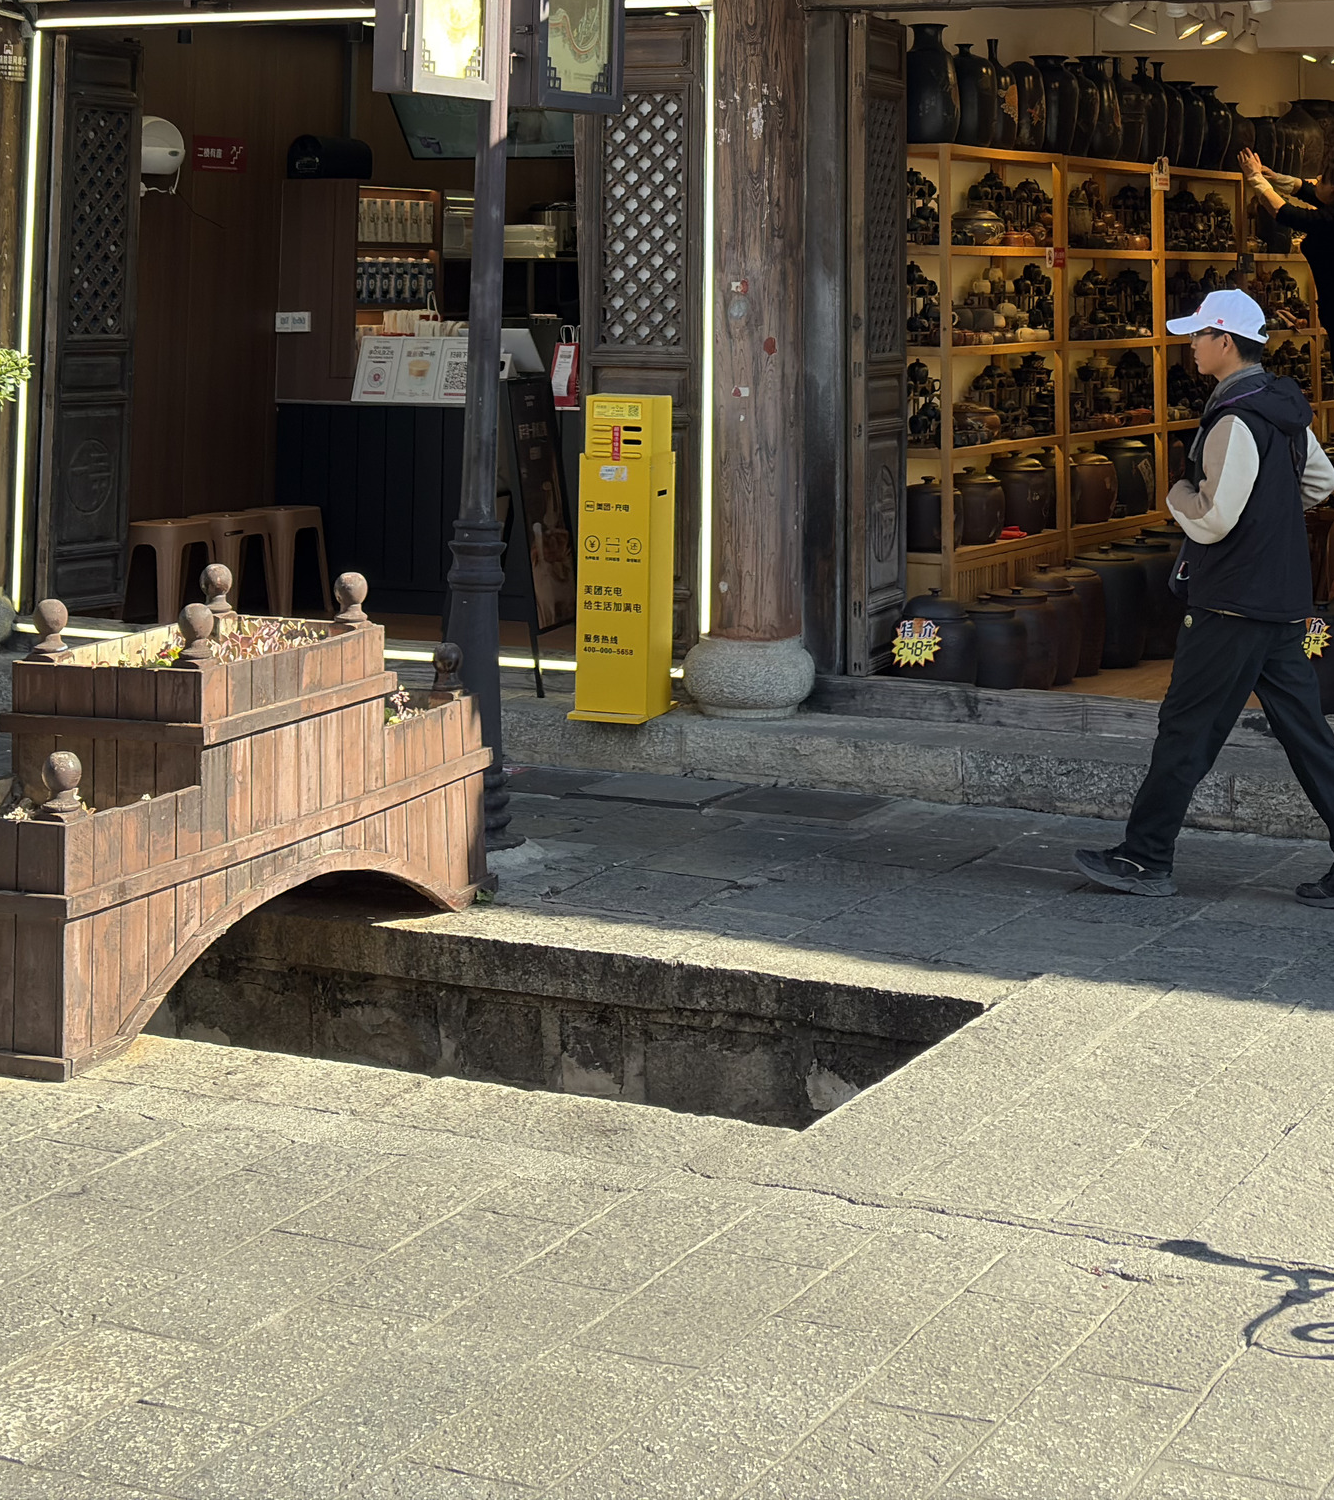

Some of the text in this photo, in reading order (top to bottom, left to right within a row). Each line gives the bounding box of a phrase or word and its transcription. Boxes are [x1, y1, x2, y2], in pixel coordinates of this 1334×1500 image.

[584, 585, 622, 597] 美团充电
[583, 600, 642, 613] 给生活加满电
[583, 634, 618, 644] 服务热线
